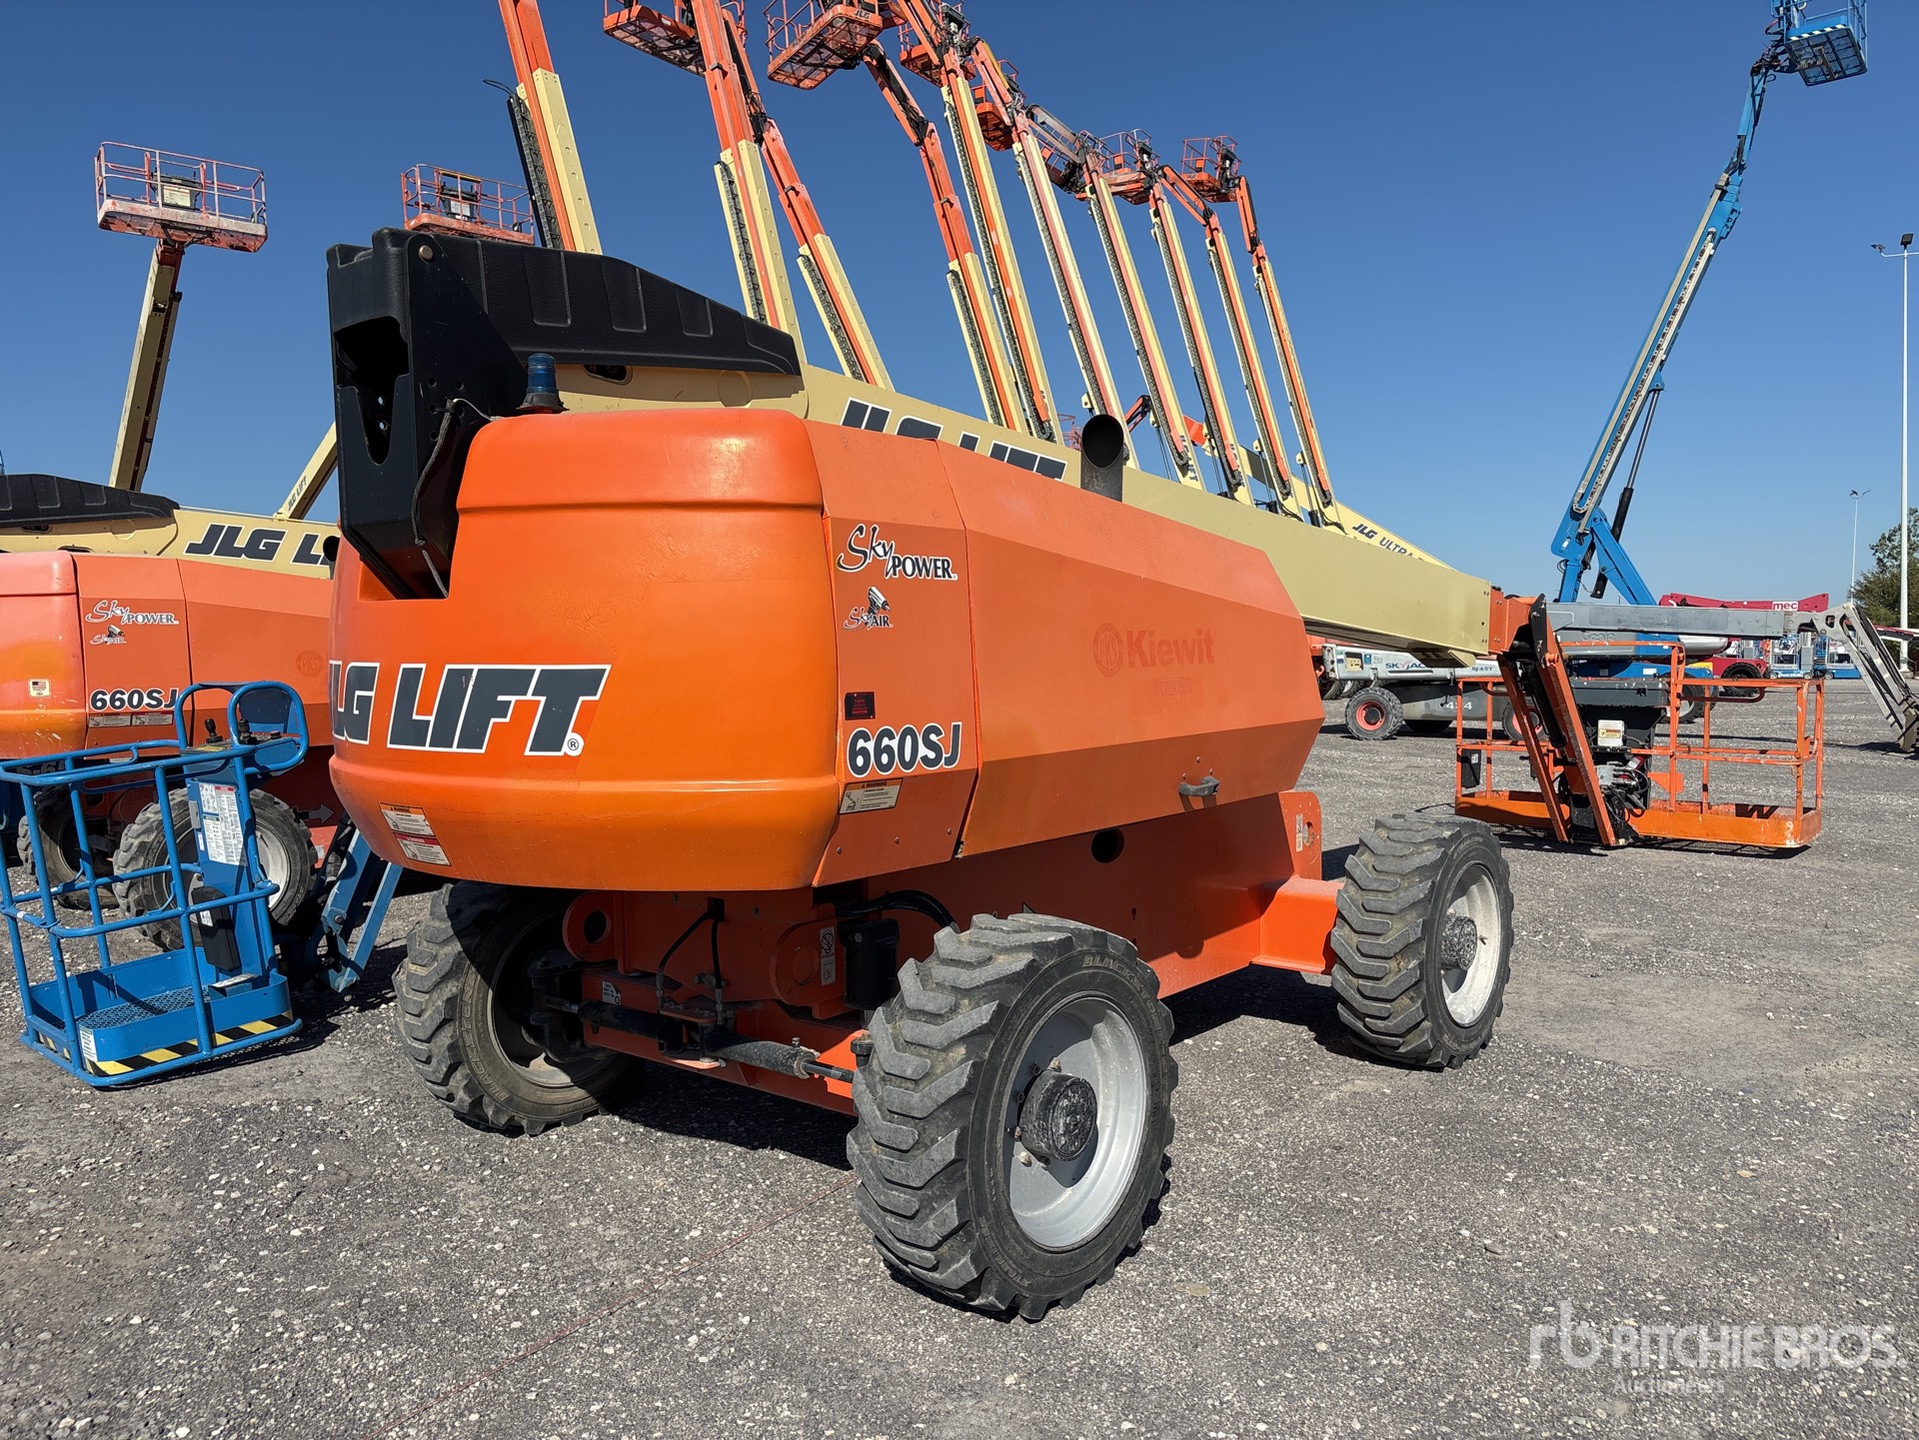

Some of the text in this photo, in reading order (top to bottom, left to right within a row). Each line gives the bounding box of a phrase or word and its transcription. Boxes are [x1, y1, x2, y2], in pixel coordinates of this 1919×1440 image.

[183, 523, 288, 562] JLG
[1352, 523, 1378, 540] JLG
[1772, 601, 1799, 611] mec
[1126, 628, 1215, 668] Kiewit
[1385, 659, 1425, 670] SKYJAC
[89, 687, 180, 712] 660SJ
[329, 660, 612, 756] LG LIFT
[1445, 701, 1473, 711] 44
[847, 721, 963, 778] 660SJ
